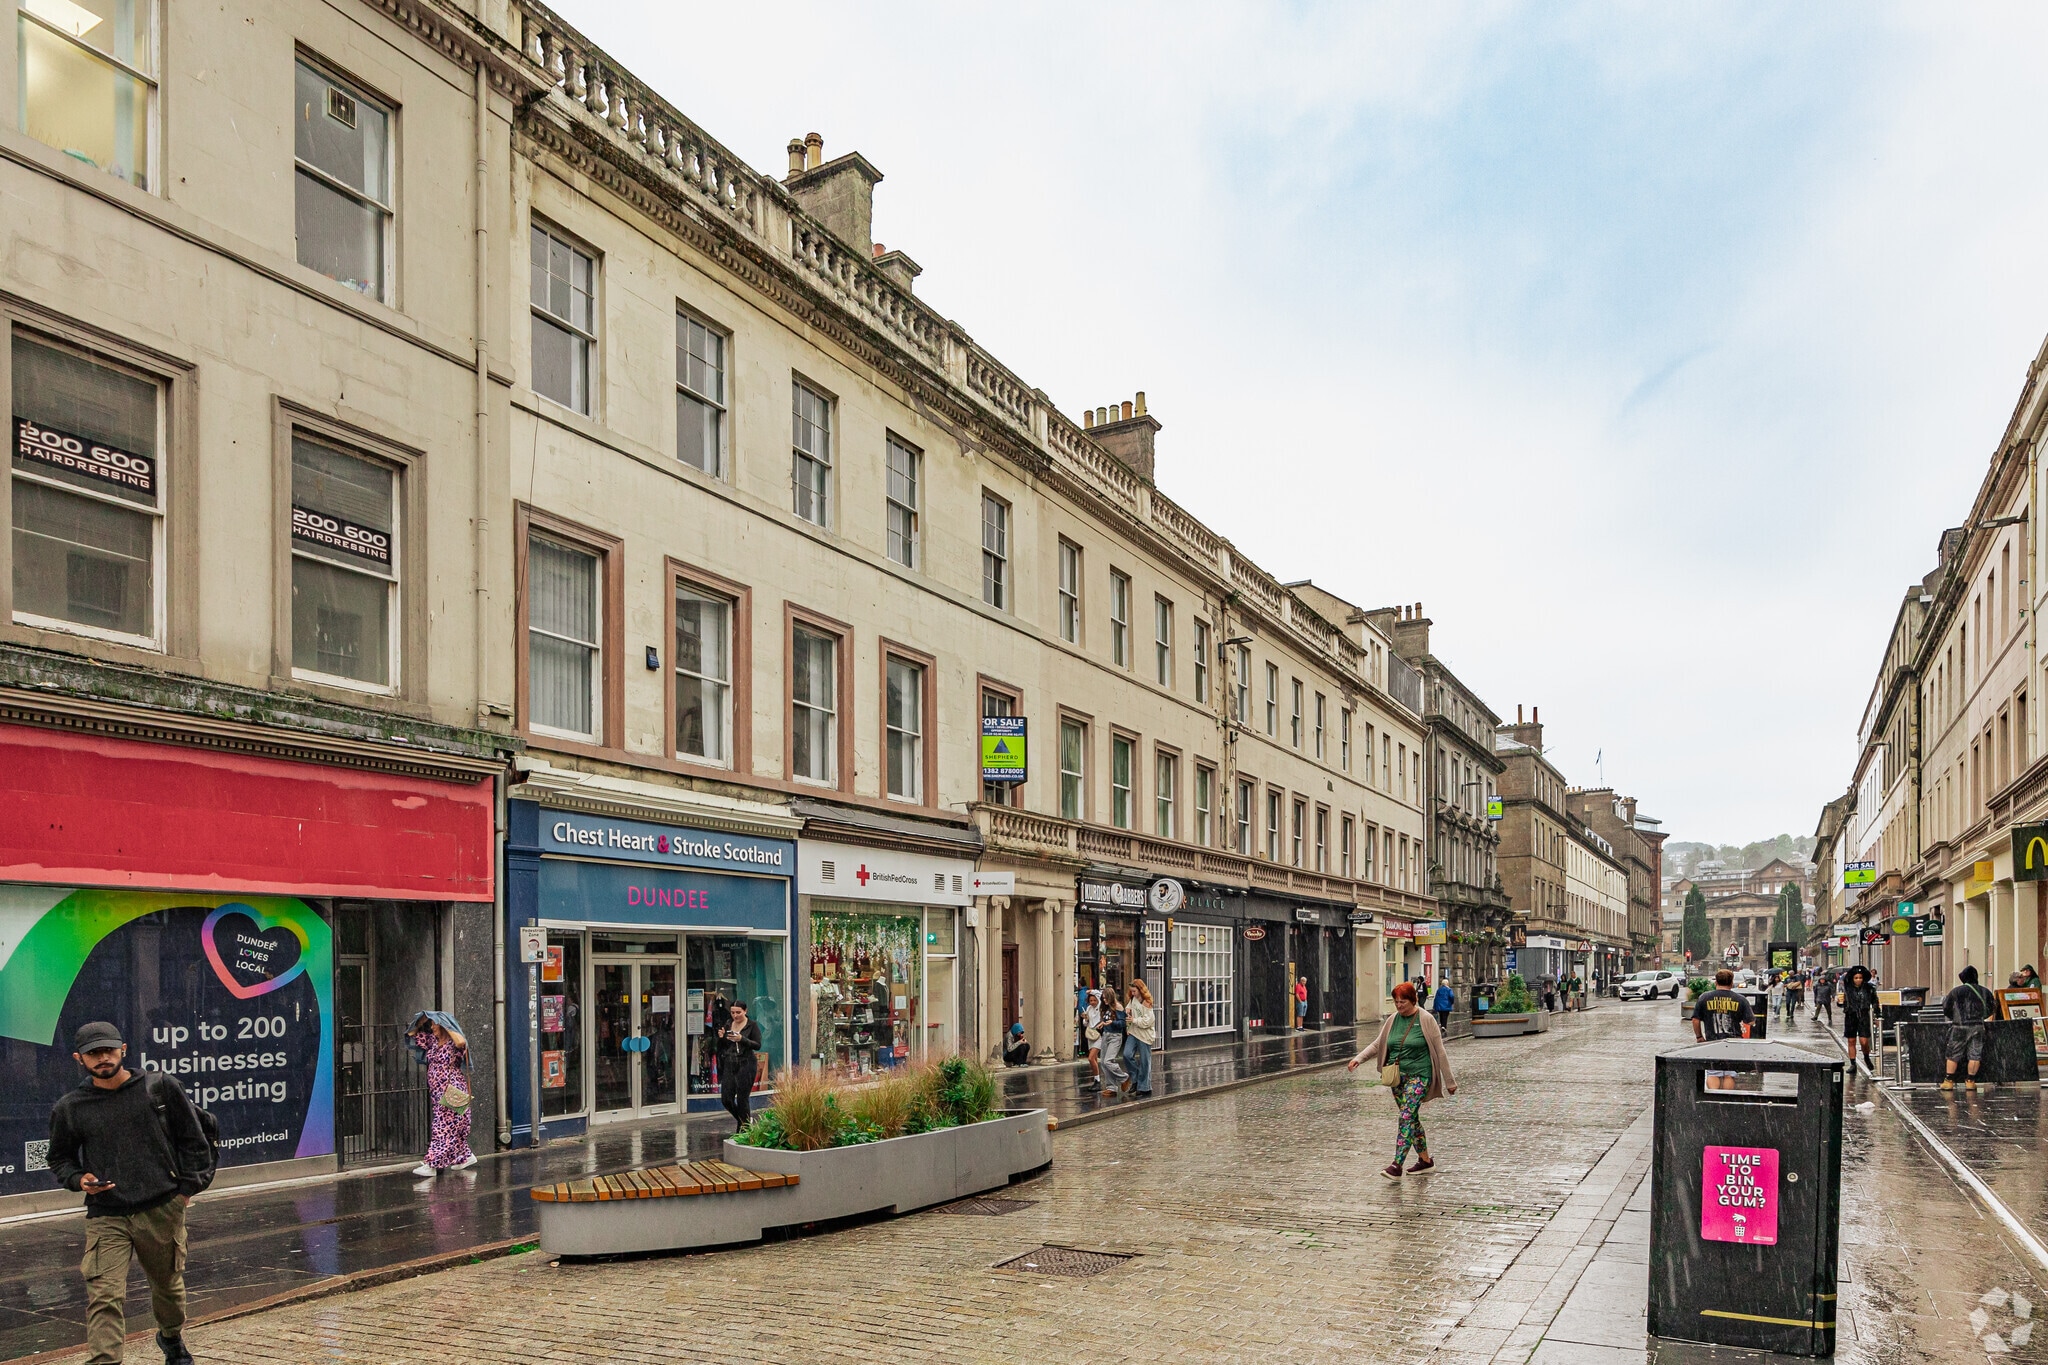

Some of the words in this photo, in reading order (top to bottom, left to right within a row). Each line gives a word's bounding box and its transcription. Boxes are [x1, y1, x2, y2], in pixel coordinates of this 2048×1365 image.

[19, 423, 83, 454] 200
[91, 446, 150, 474] 600
[20, 443, 150, 489] HAIRDRESSING
[292, 508, 339, 533] 200
[344, 525, 387, 547] 600
[293, 525, 387, 560] HAIRDRESSING
[1000, 718, 1024, 727] SALE
[552, 822, 605, 846] Chest
[608, 828, 655, 852] Heart
[657, 834, 670, 853] &
[673, 836, 721, 859] Stroke
[724, 842, 782, 866] Scotland
[628, 885, 709, 909] DUNDEE
[1084, 883, 1111, 902] KURDISH
[1121, 888, 1145, 905] ARBERS
[1190, 896, 1225, 910] PLACE
[1402, 922, 1412, 932] NAILS
[1430, 928, 1445, 936] LET
[237, 933, 275, 951] DUNDEE
[235, 960, 266, 974] LOCAL
[2012, 1009, 2028, 1018] BIG
[153, 1025, 189, 1049] up
[198, 1021, 228, 1041] to
[237, 1016, 287, 1039] 200
[140, 1051, 288, 1075] businesses
[218, 1129, 289, 1150] upportlocal
[1720, 1153, 1761, 1166] TIME
[1729, 1164, 1752, 1175] TO
[1726, 1174, 1754, 1186] BIN
[1716, 1184, 1764, 1197] YOUR
[1718, 1195, 1766, 1208] GUM?
